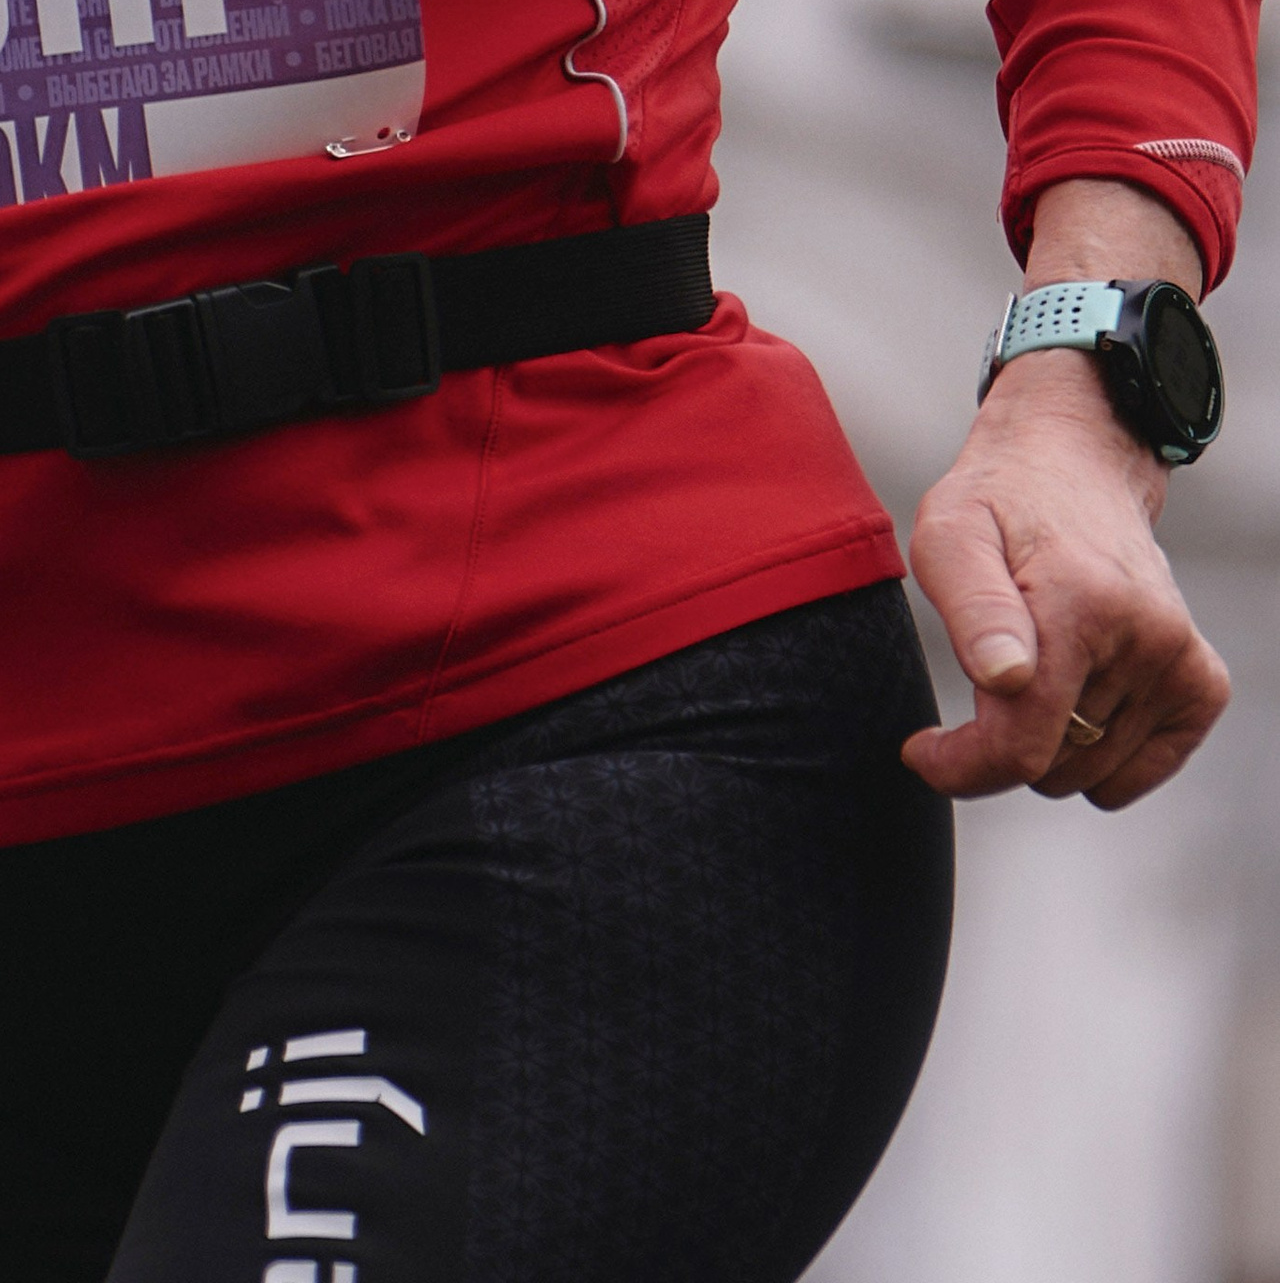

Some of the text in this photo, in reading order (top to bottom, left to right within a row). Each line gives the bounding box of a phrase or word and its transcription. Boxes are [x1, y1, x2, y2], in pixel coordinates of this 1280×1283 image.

[46, 63, 158, 107] ВЫБЕГАЮ
[160, 58, 192, 93] ЗА
[192, 48, 272, 89] РАМКИ
[314, 28, 416, 72] БЕГОВАЯ
[238, 1027, 426, 1283] nji
